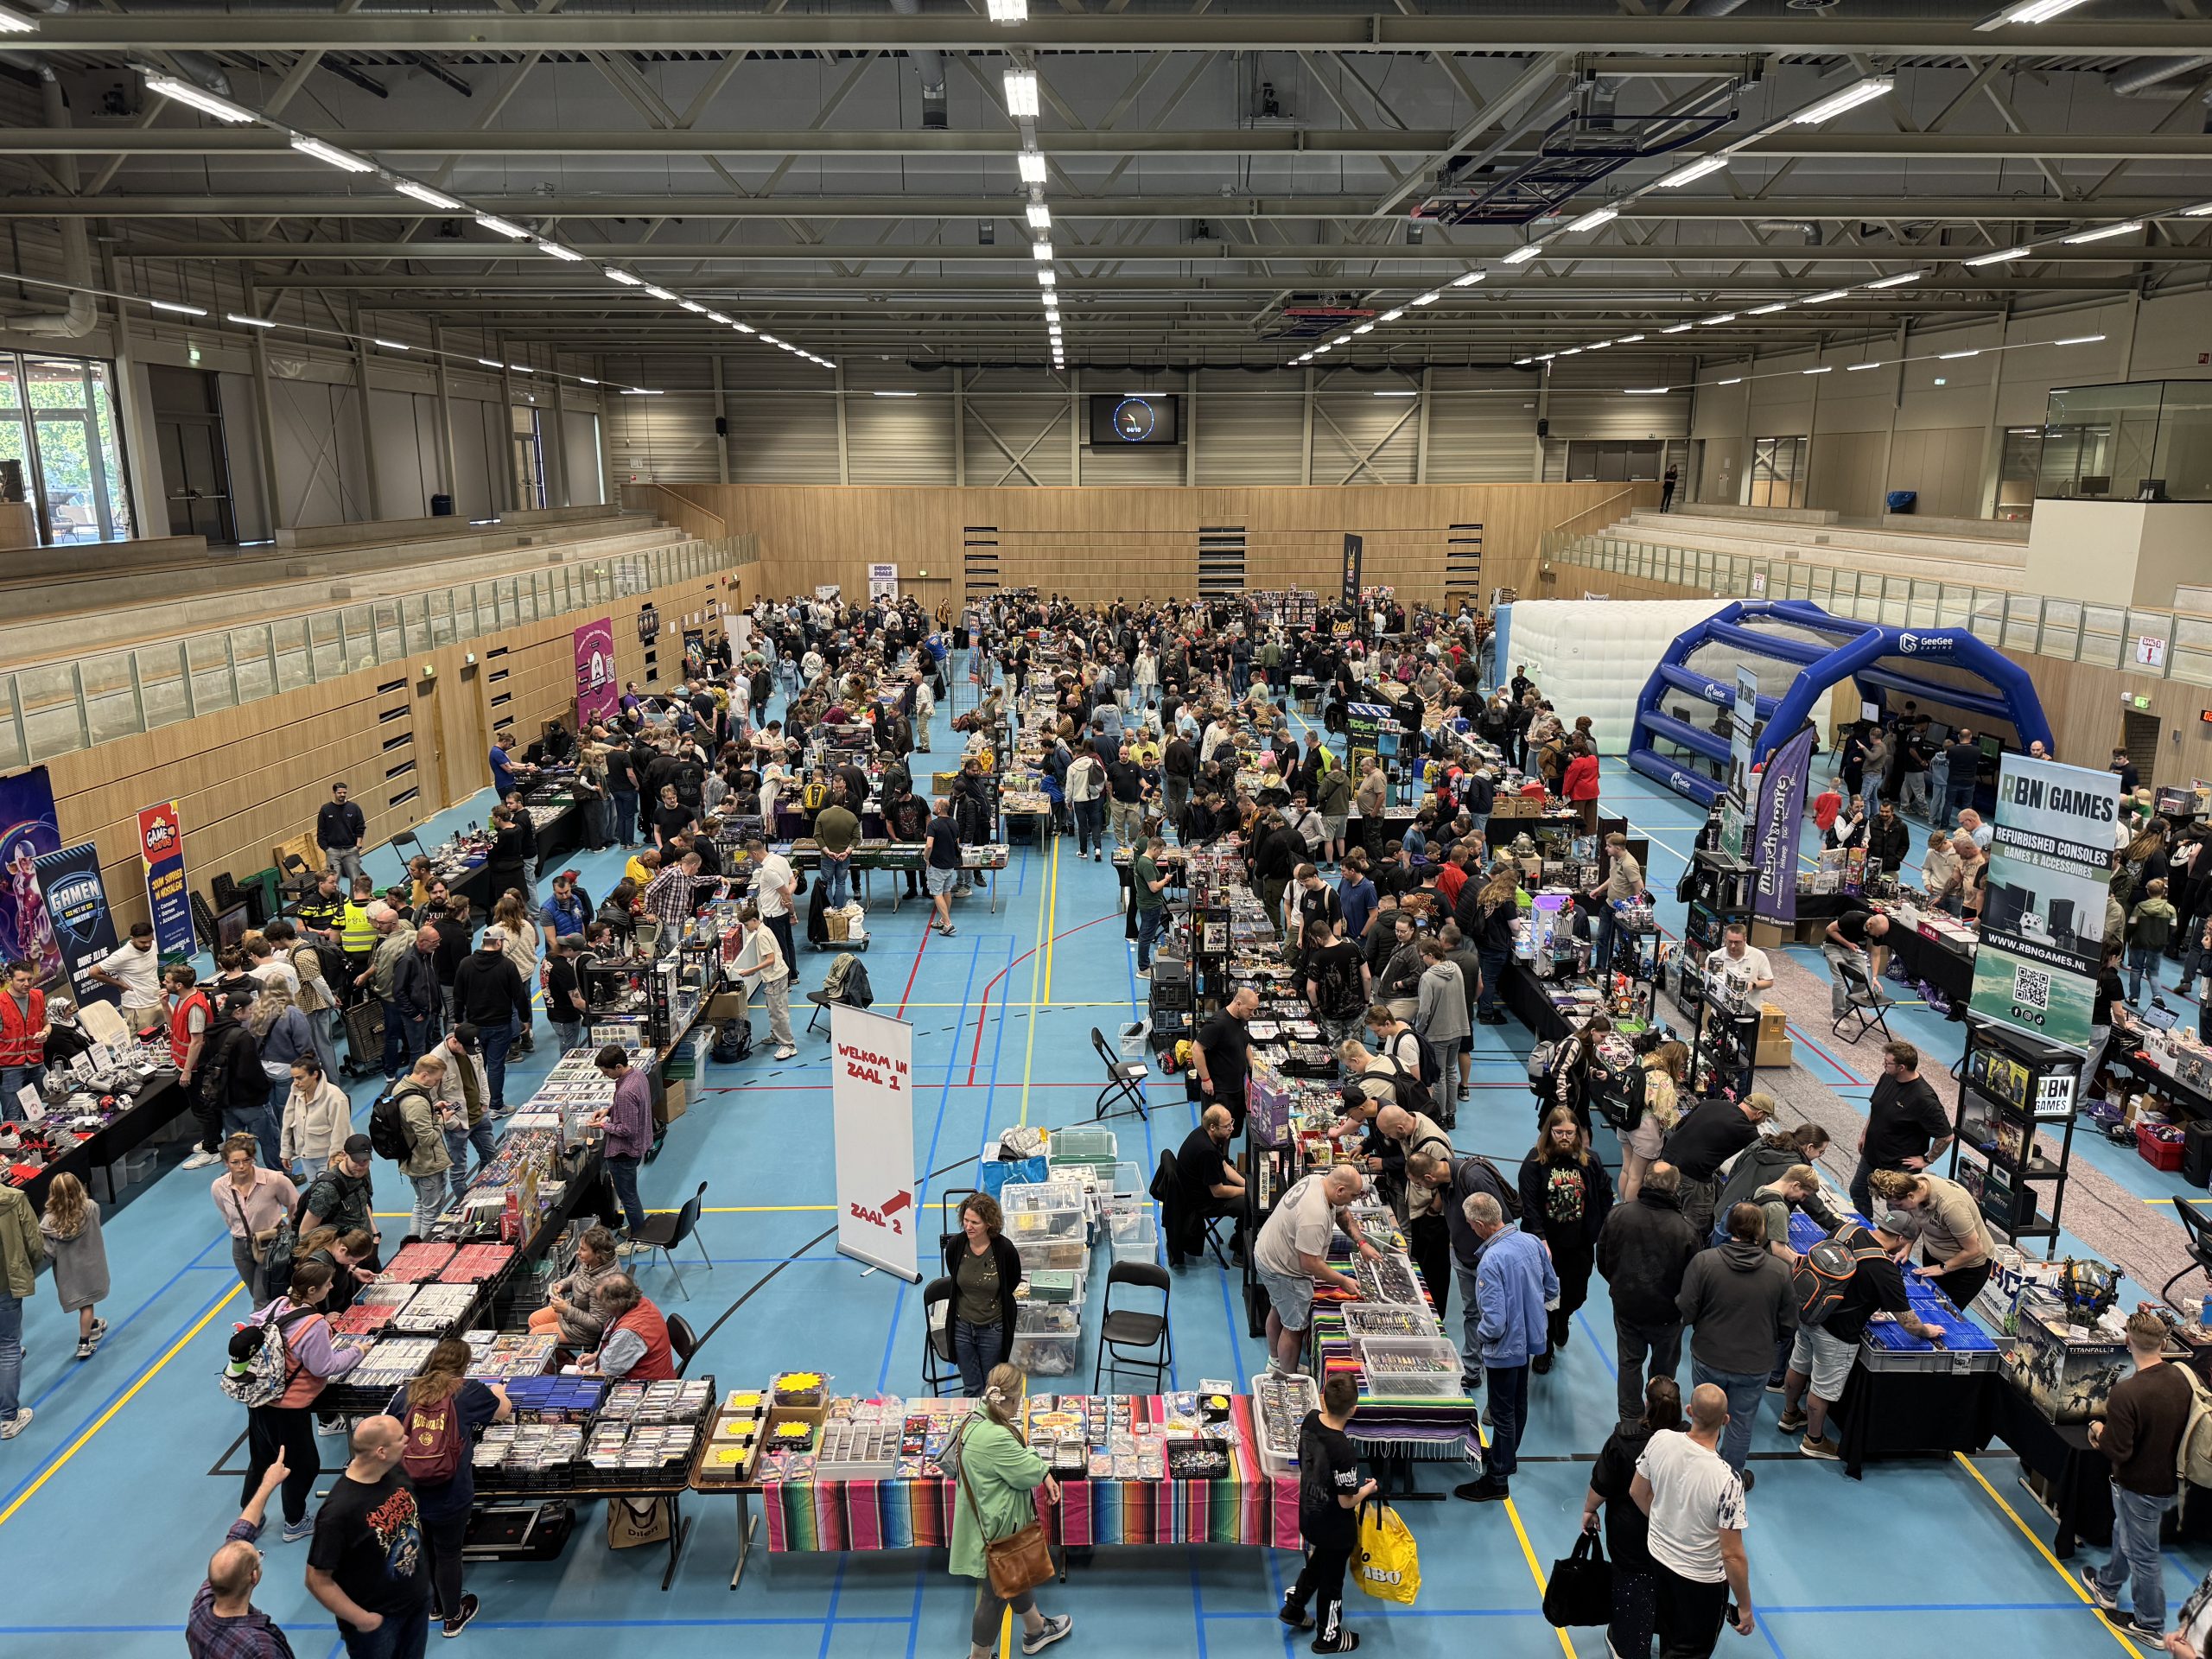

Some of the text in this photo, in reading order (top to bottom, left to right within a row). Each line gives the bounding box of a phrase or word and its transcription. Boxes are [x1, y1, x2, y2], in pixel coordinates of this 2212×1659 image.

[1921, 637, 1953, 645] GeeGee
[2001, 773, 2114, 822] RBN GAMES
[147, 827, 168, 848] GAME
[1996, 826, 2107, 867] REFURBISHED CONSOLES
[2004, 846, 2093, 879] GAMES & ACCESSOIRES
[50, 880, 101, 912] GAMEN
[160, 899, 178, 910] Consoles
[73, 906, 82, 915] MET
[162, 907, 175, 917] Games
[162, 910, 185, 925] Accessoires
[77, 953, 93, 968] DURF
[1988, 933, 2088, 972] WWW.RBNGAMES.NL
[837, 1043, 907, 1075] WELKOM IN
[848, 1061, 900, 1091] ZAAL 1
[2037, 1079, 2069, 1097] RBN
[2035, 1098, 2067, 1110] GAMES
[851, 1202, 903, 1236] ZAAL 2
